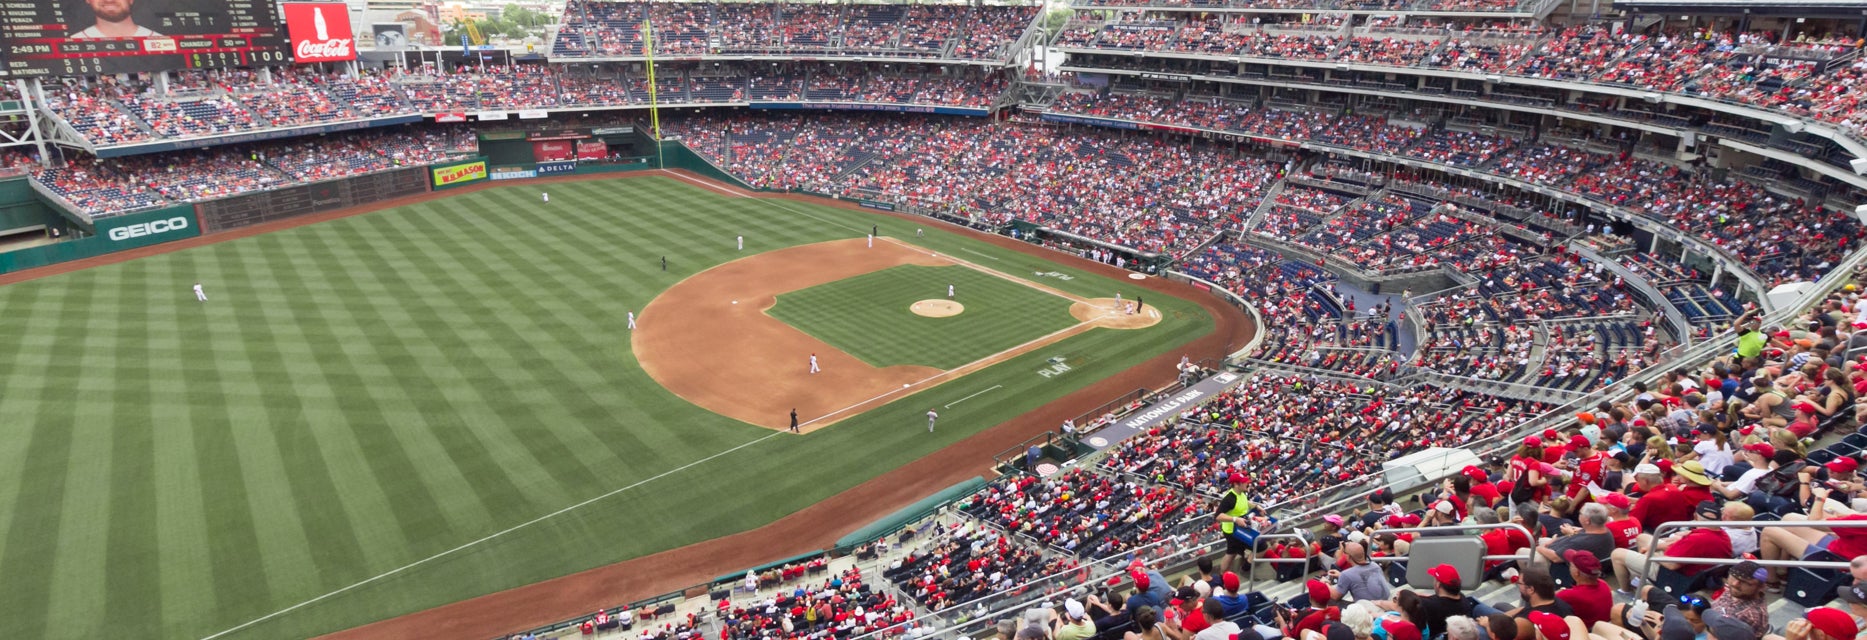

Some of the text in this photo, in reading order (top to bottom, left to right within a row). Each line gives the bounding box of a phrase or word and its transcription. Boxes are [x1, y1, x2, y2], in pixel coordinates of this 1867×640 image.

[11, 44, 50, 54] 2:49 PM
[151, 41, 161, 49] 82
[180, 40, 213, 48] CHANGEUP
[297, 39, 351, 59] Coca-Cola
[63, 58, 71, 66] 5
[93, 57, 100, 65] 0
[219, 52, 226, 60] 0
[208, 59, 215, 67] 3
[250, 52, 283, 62] 1 0 0
[108, 216, 188, 241] GEICO
[1036, 362, 1072, 378] PLAY
[1125, 389, 1204, 429] NATIONALS PARK
[1623, 526, 1639, 538] SPAN
